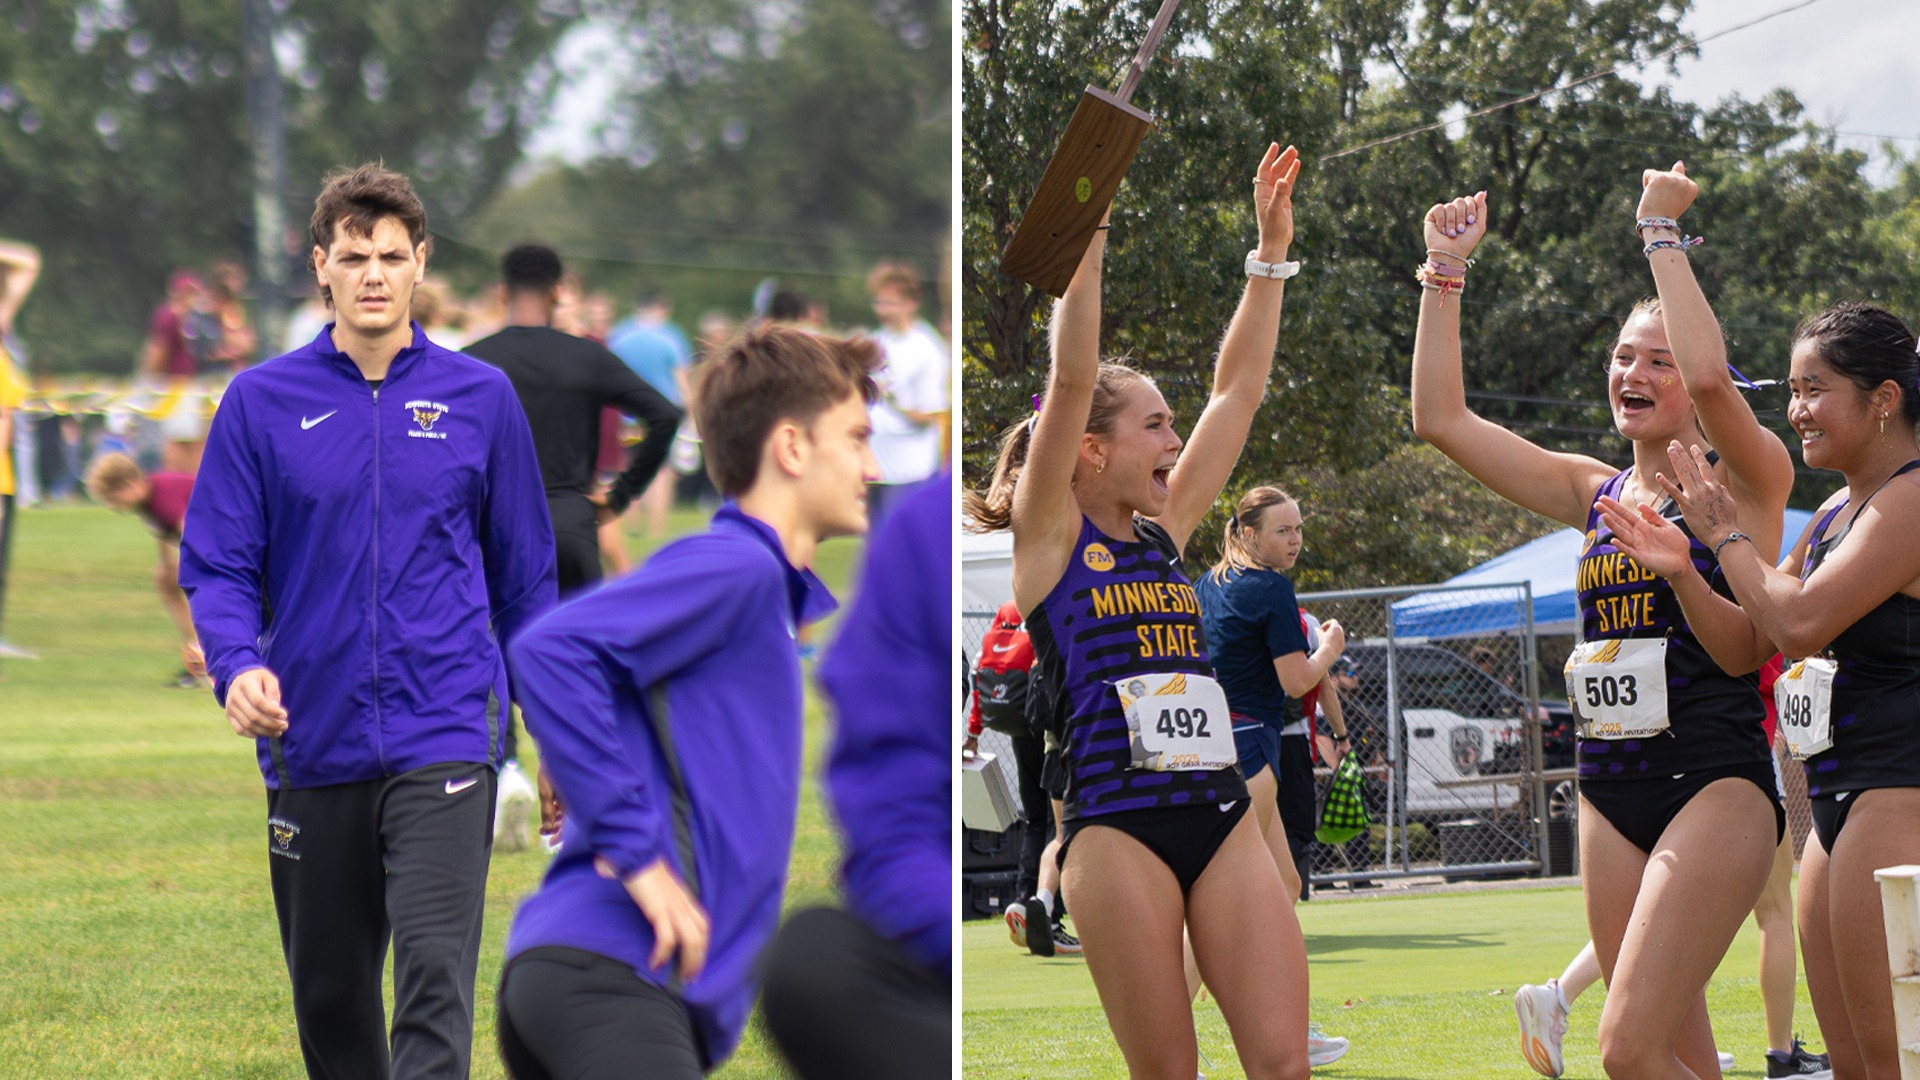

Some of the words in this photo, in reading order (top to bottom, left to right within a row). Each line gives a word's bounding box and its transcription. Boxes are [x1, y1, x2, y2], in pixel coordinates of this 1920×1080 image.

[1086, 551, 1112, 563] FM
[1595, 592, 1655, 633] STATE
[1136, 624, 1200, 658] STATE
[1584, 674, 1638, 708] 503
[1156, 707, 1211, 739] 492
[1784, 693, 1812, 728] 498
[1600, 722, 1622, 734] 2025
[1171, 754, 1200, 765] 2025
